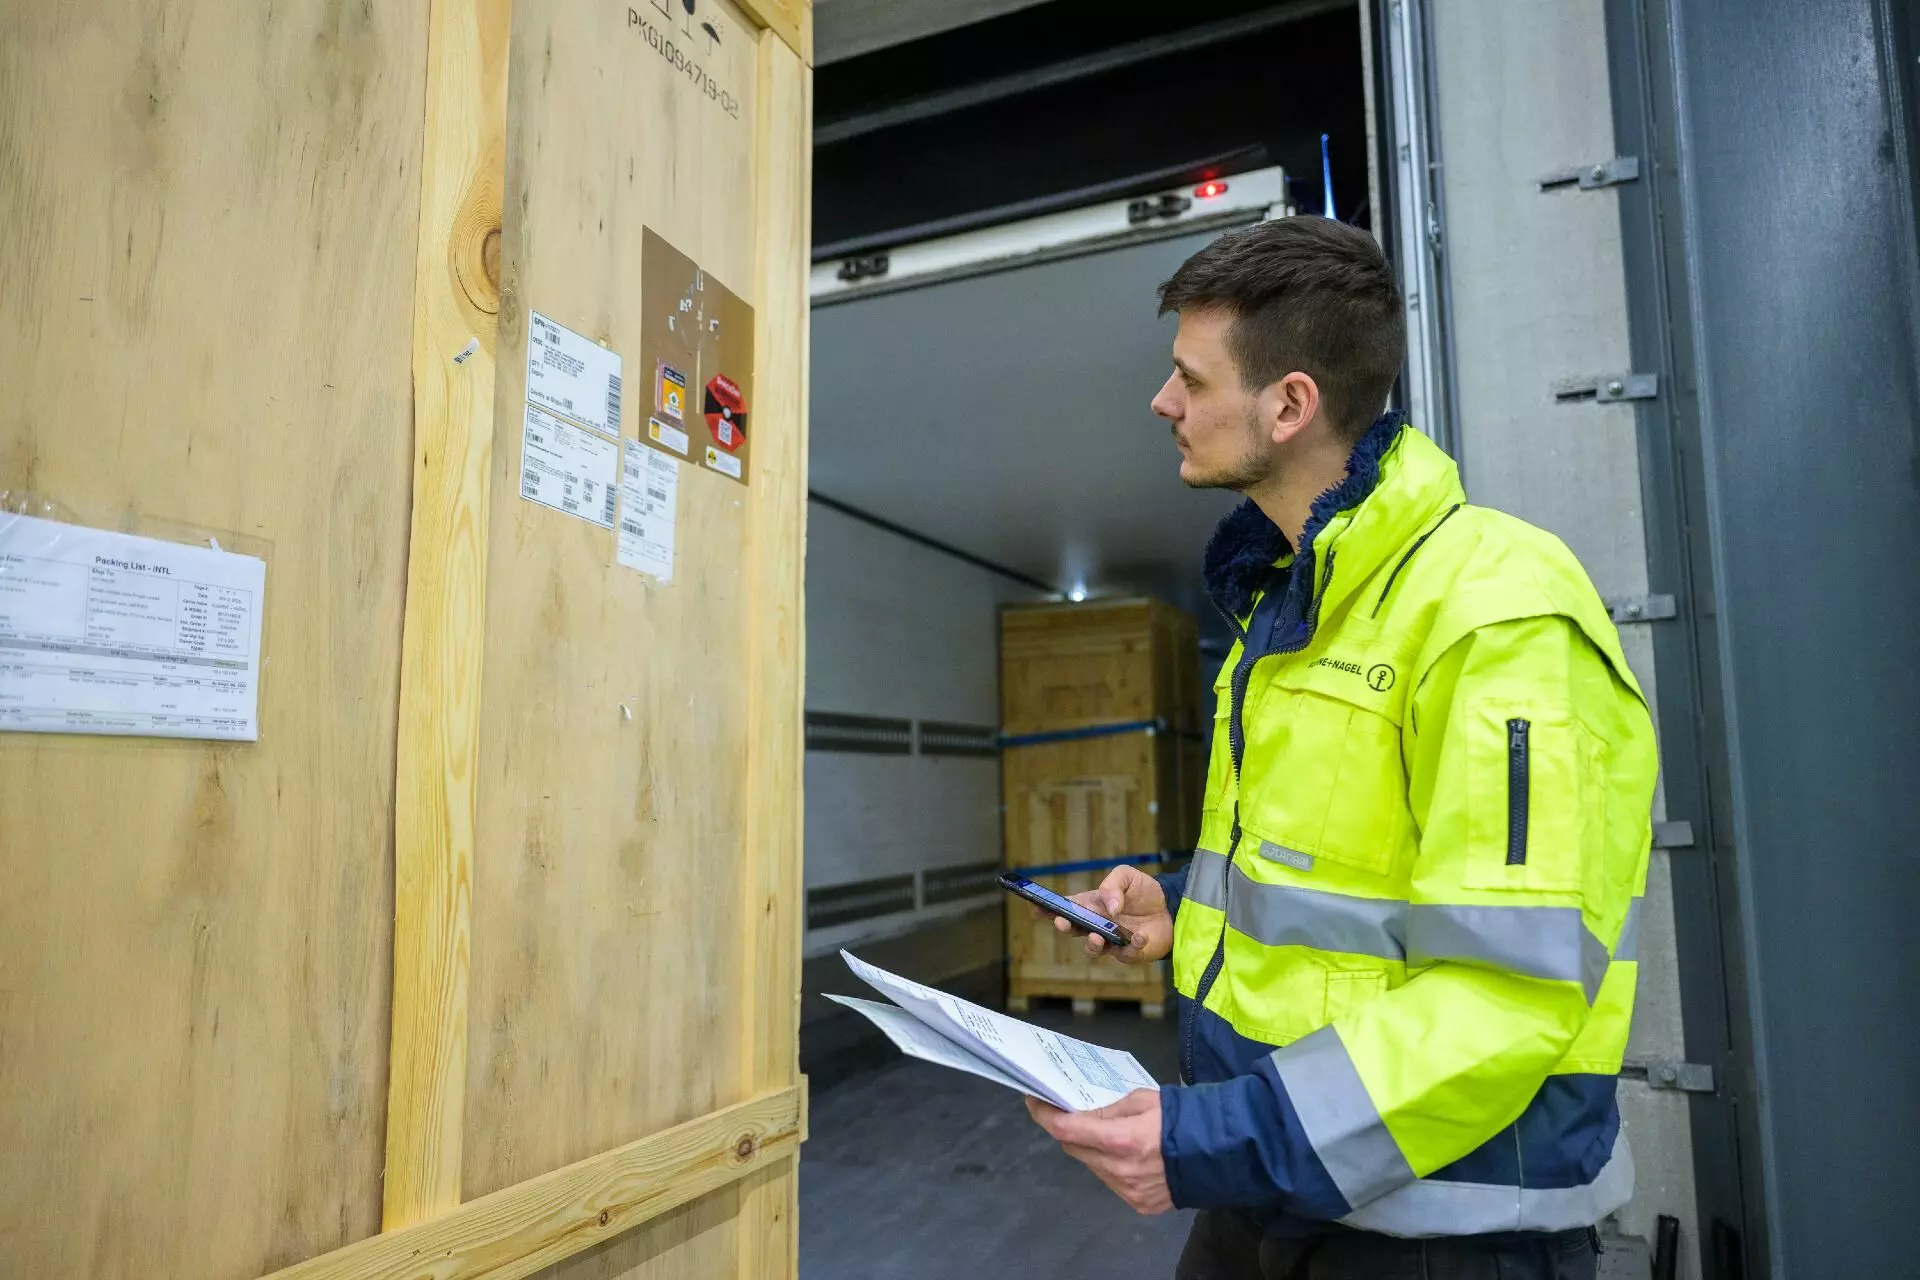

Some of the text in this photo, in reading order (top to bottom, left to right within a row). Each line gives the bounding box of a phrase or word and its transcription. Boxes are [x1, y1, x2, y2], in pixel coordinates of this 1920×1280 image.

[95, 556, 129, 570] Packing
[131, 562, 146, 571] List
[152, 565, 173, 575] INTL
